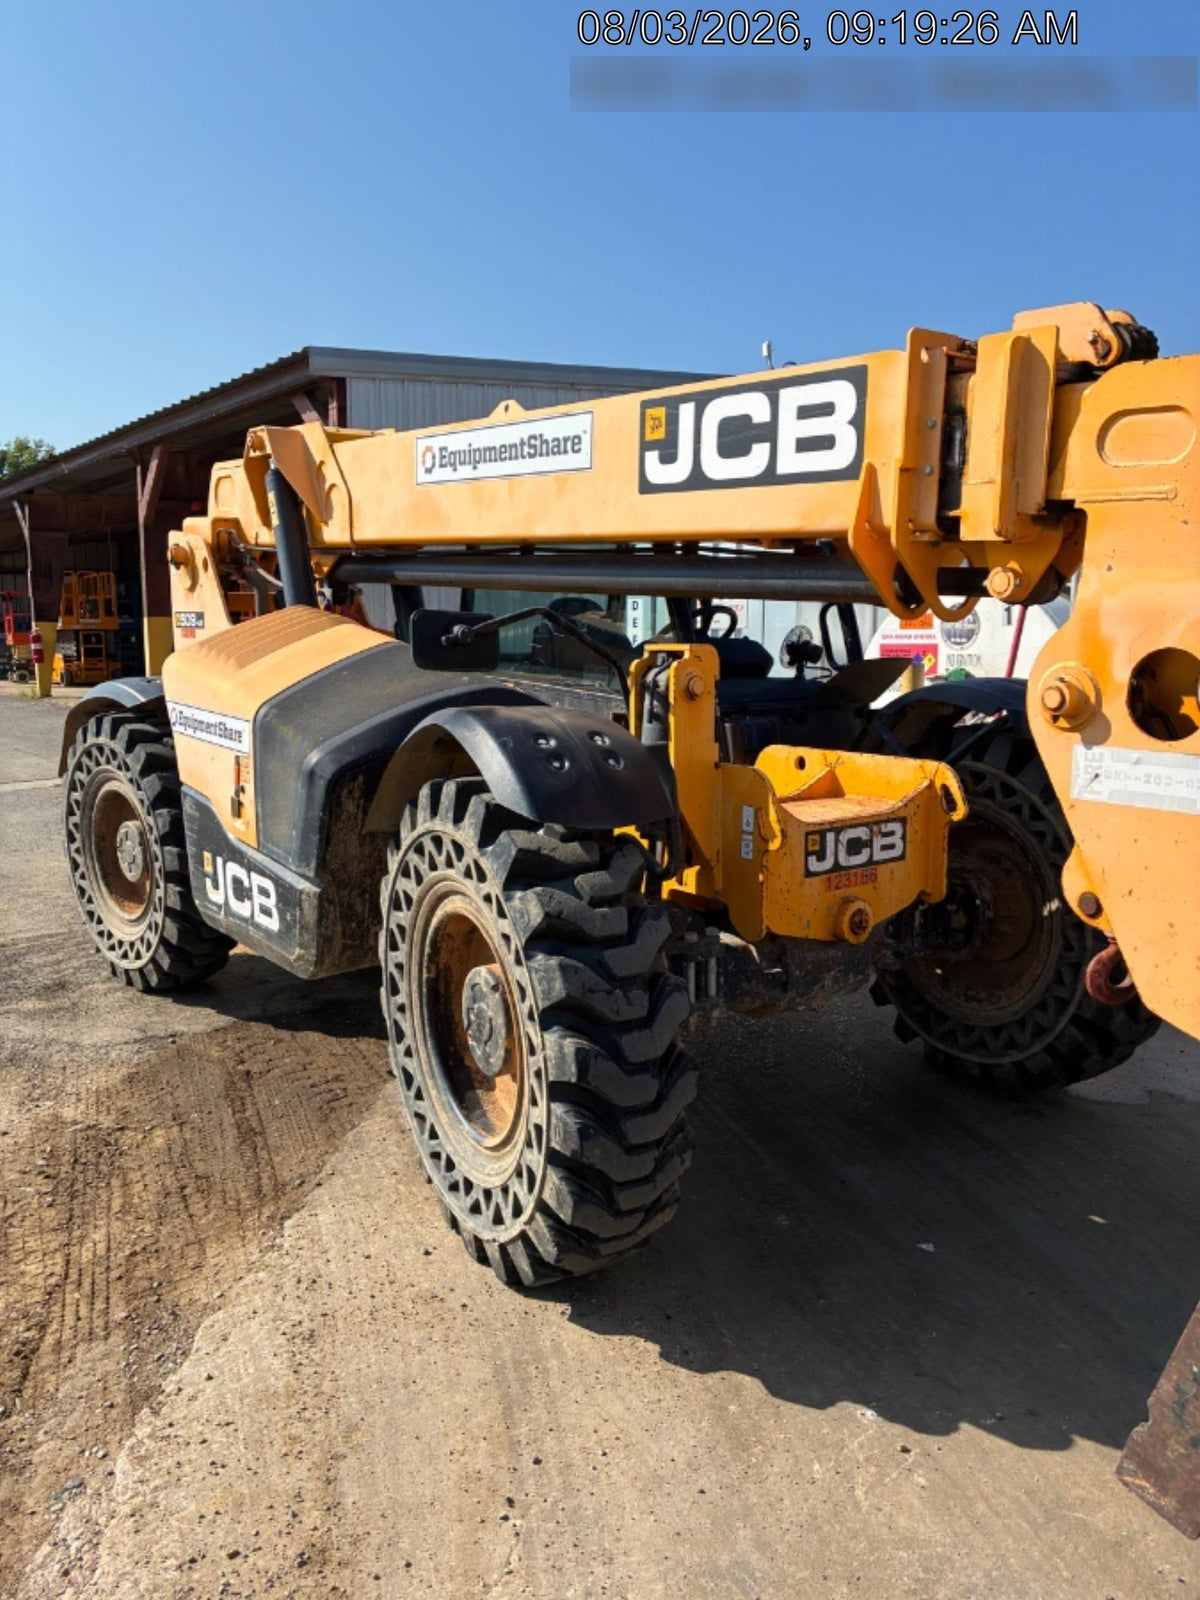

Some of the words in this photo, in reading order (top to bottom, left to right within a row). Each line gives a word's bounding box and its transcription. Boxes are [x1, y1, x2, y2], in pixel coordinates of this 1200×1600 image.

[438, 434, 583, 470] EquipmentShare
[644, 379, 858, 485] JCB
[178, 710, 243, 744] EquipmentShare
[807, 822, 904, 873] JCB
[205, 856, 280, 932] JCB
[825, 867, 878, 894] 123166
